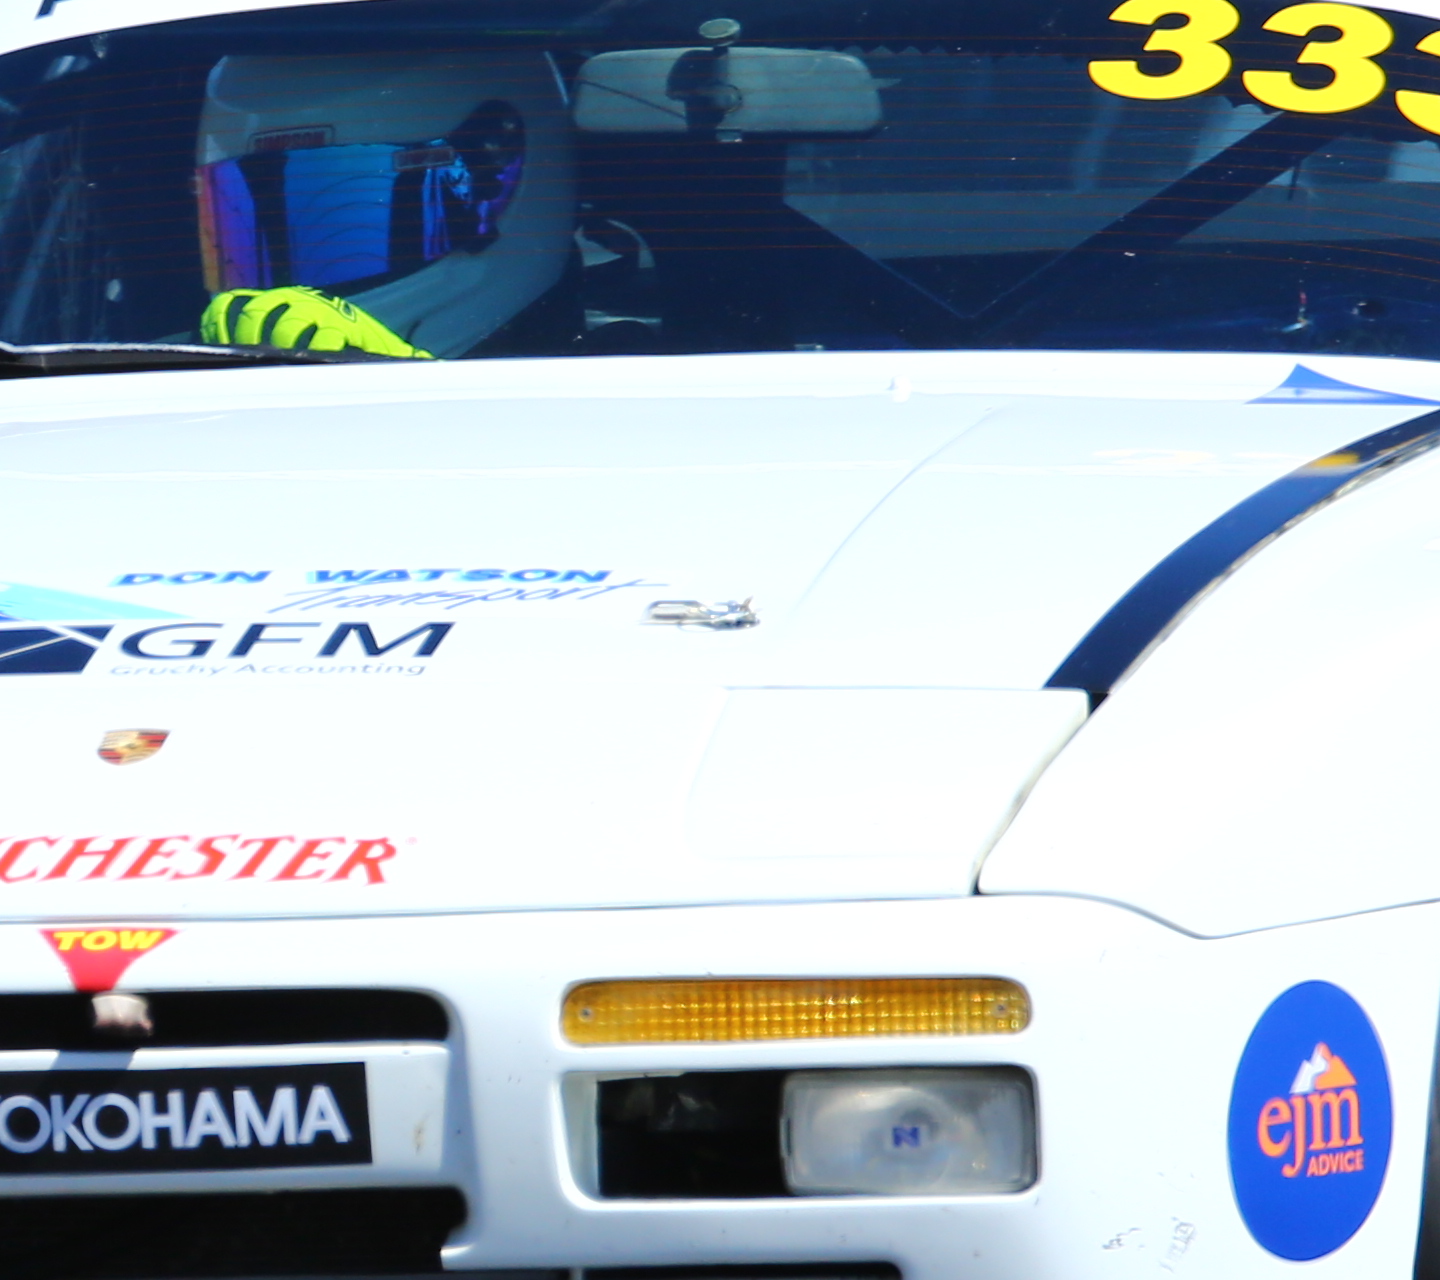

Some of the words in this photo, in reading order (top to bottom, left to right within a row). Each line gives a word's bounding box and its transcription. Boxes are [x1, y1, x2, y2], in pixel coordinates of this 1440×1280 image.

[112, 570, 272, 586] DON
[309, 568, 613, 584] WATSON
[267, 579, 670, 613] Transport
[119, 621, 456, 661] GFM
[233, 662, 427, 677] Accounting
[52, 927, 165, 952] TOW
[1256, 1086, 1365, 1179] ejm
[1306, 1149, 1365, 1178] ADVICE
